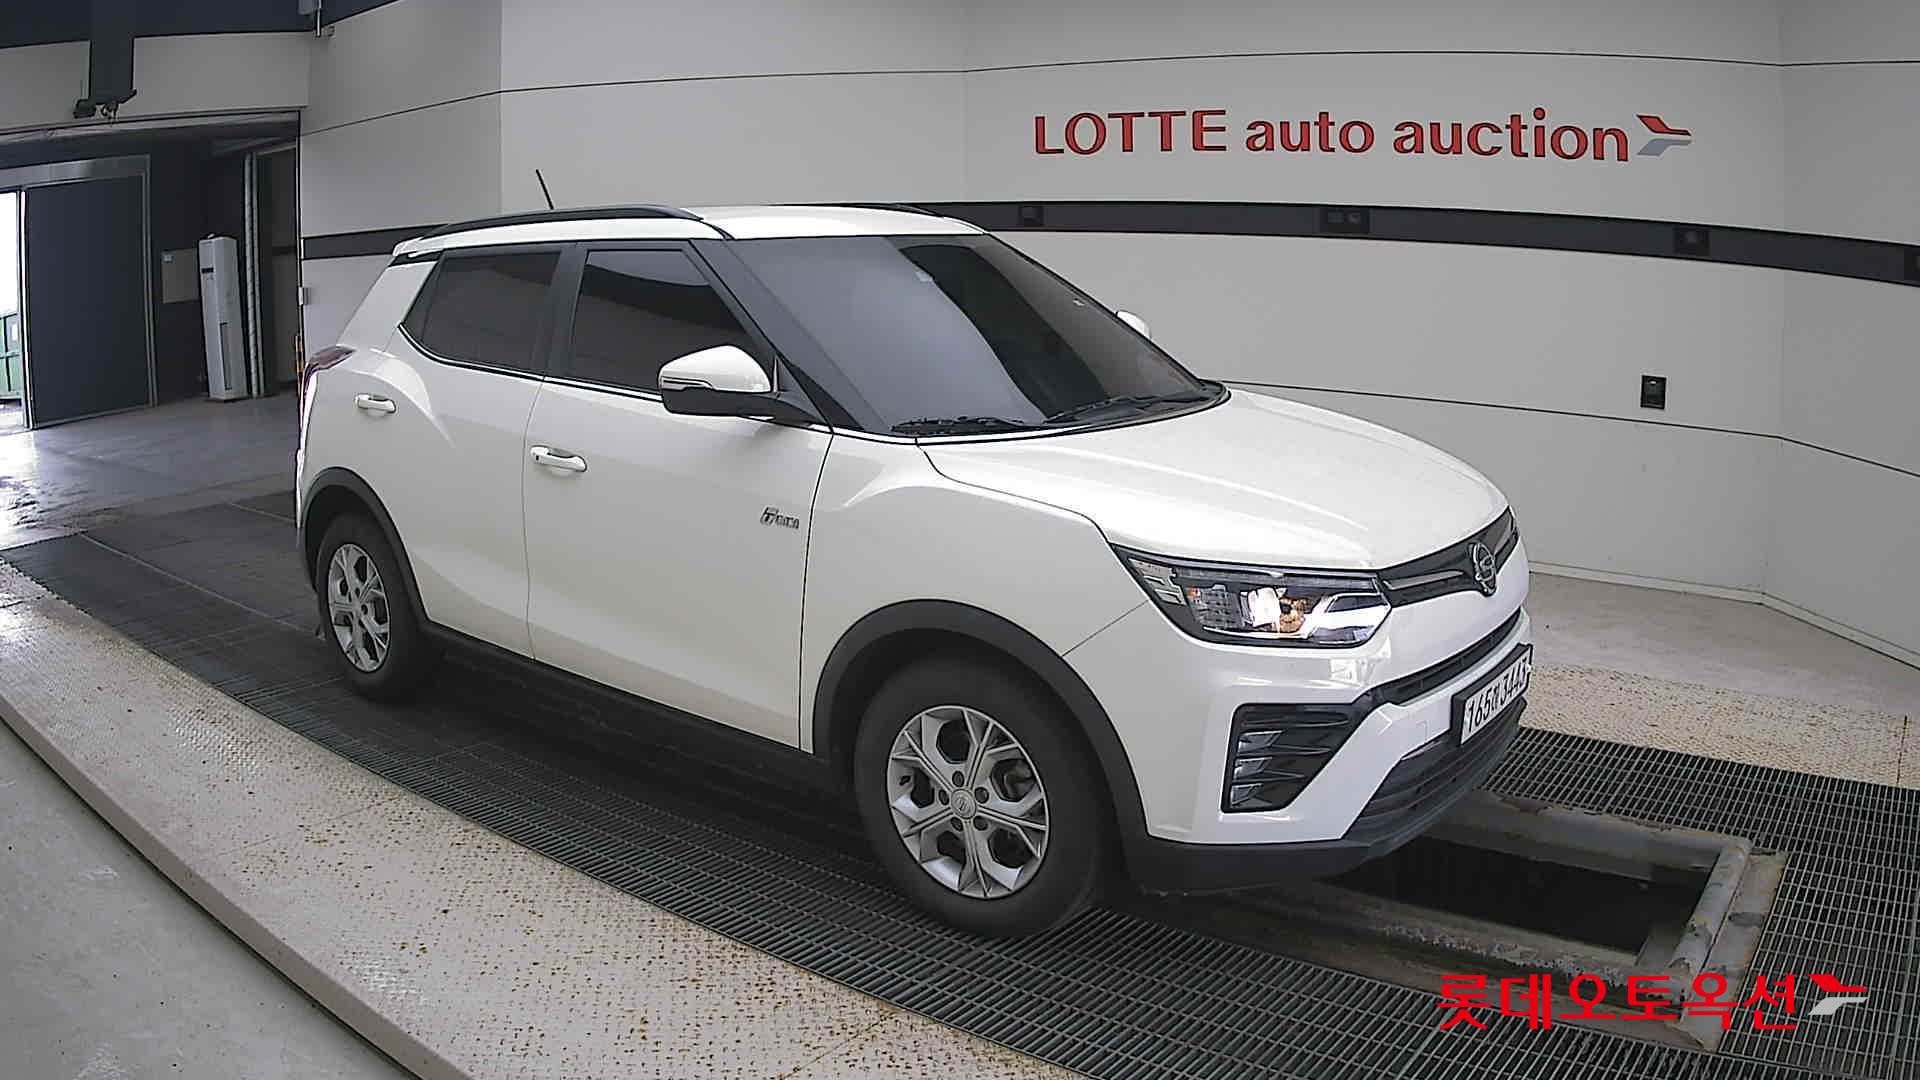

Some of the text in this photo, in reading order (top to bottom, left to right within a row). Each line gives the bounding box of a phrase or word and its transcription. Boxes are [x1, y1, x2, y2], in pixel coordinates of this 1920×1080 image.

[1035, 107, 1629, 162] LOTTE auto auction
